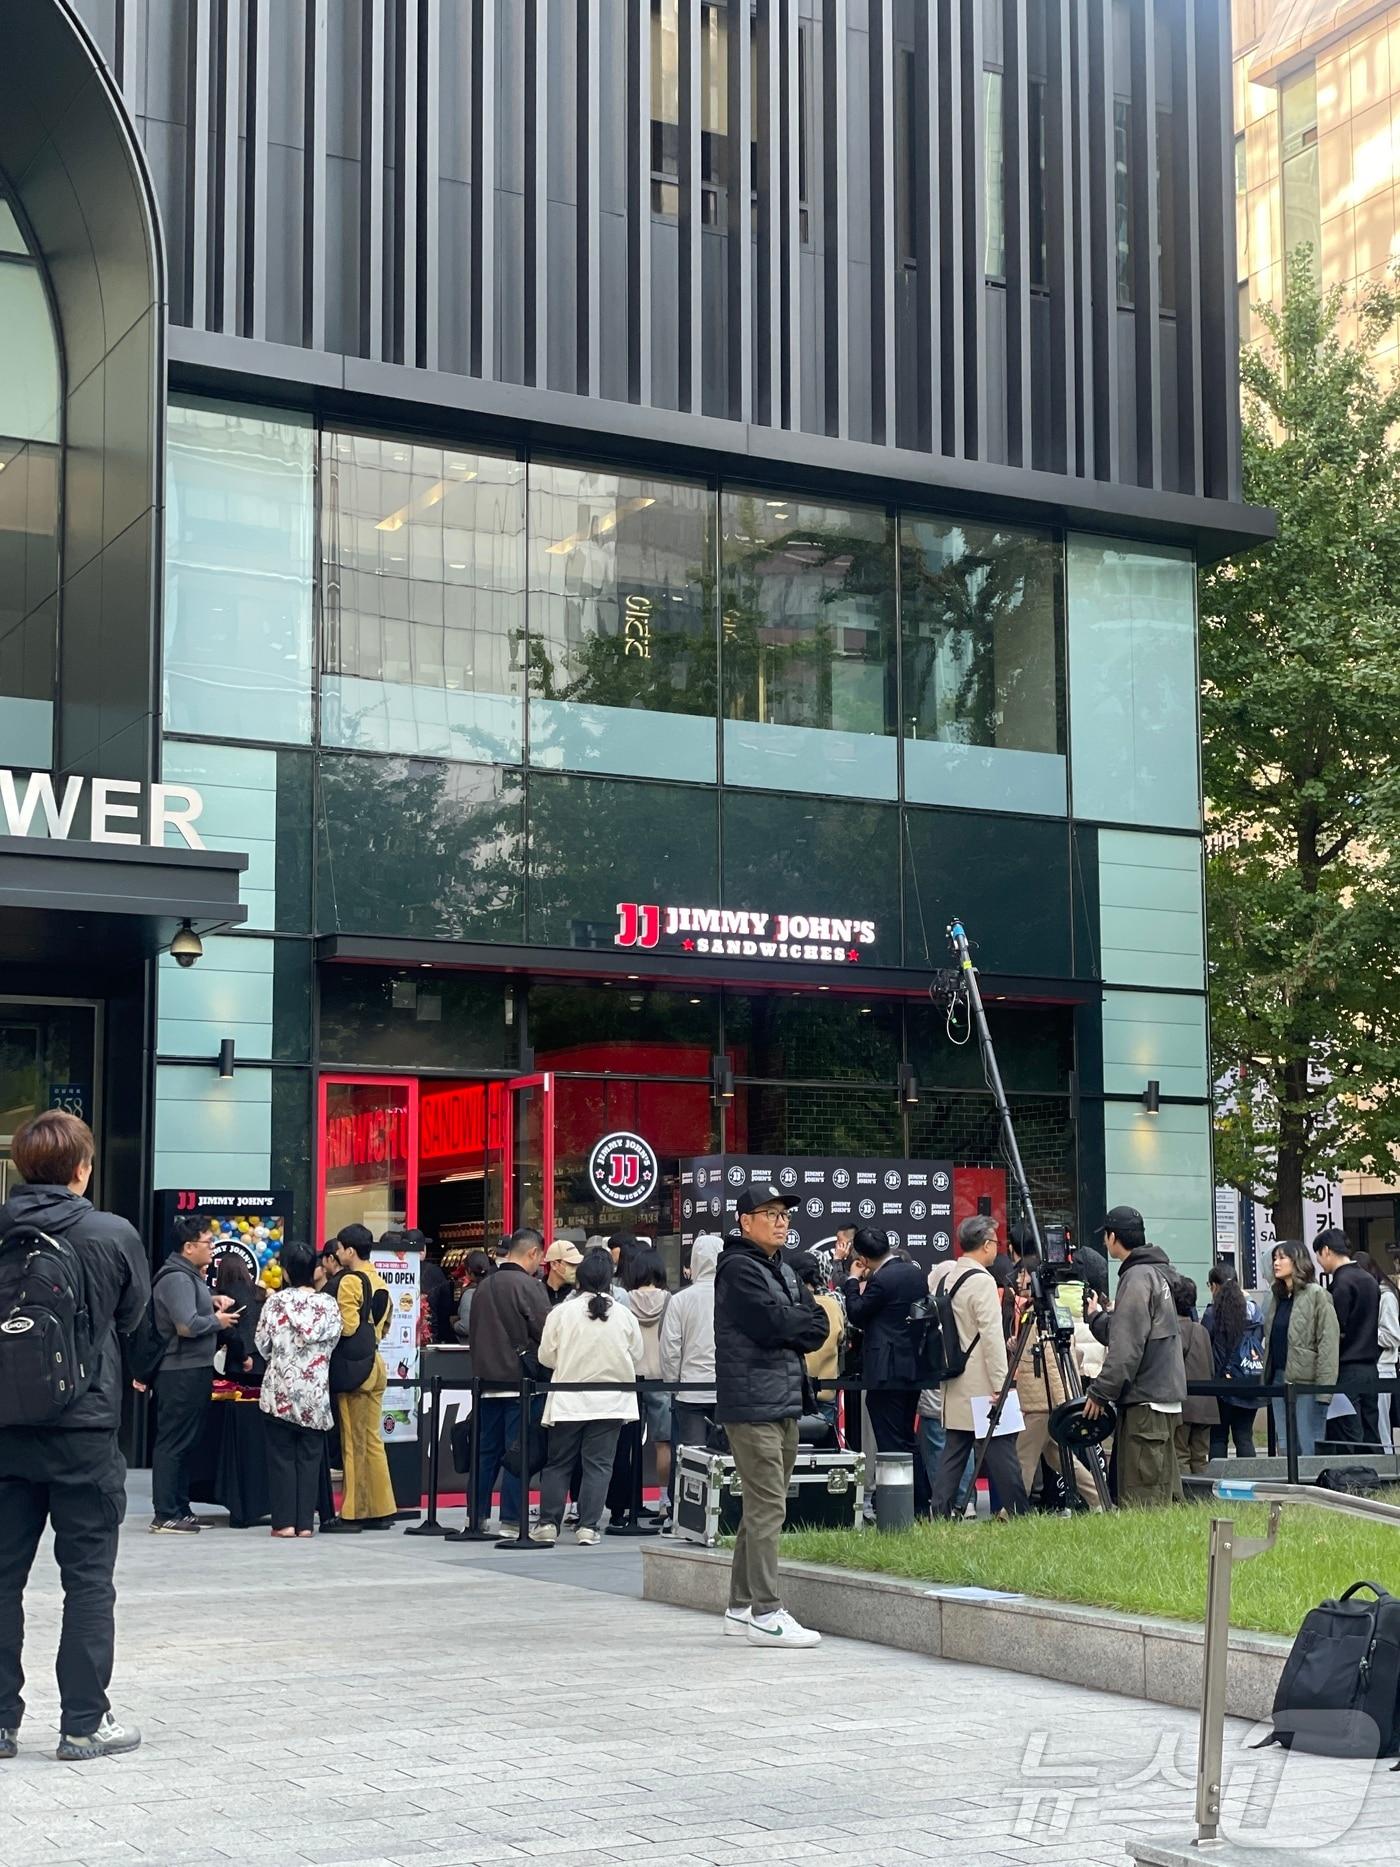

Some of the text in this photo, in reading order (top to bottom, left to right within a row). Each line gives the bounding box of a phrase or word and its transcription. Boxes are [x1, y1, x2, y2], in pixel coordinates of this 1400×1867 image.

[614, 903, 876, 949] JJ JIMMY JOHN'S
[697, 938, 846, 961] SANDWICHES
[597, 1139, 651, 1166] JIMMY JOHN'S
[608, 1154, 640, 1187] JJ
[177, 1192, 274, 1210] JJ JIMMY JOHN'S
[229, 1245, 253, 1269] JOHN'S
[395, 1272, 415, 1285] OPEN
